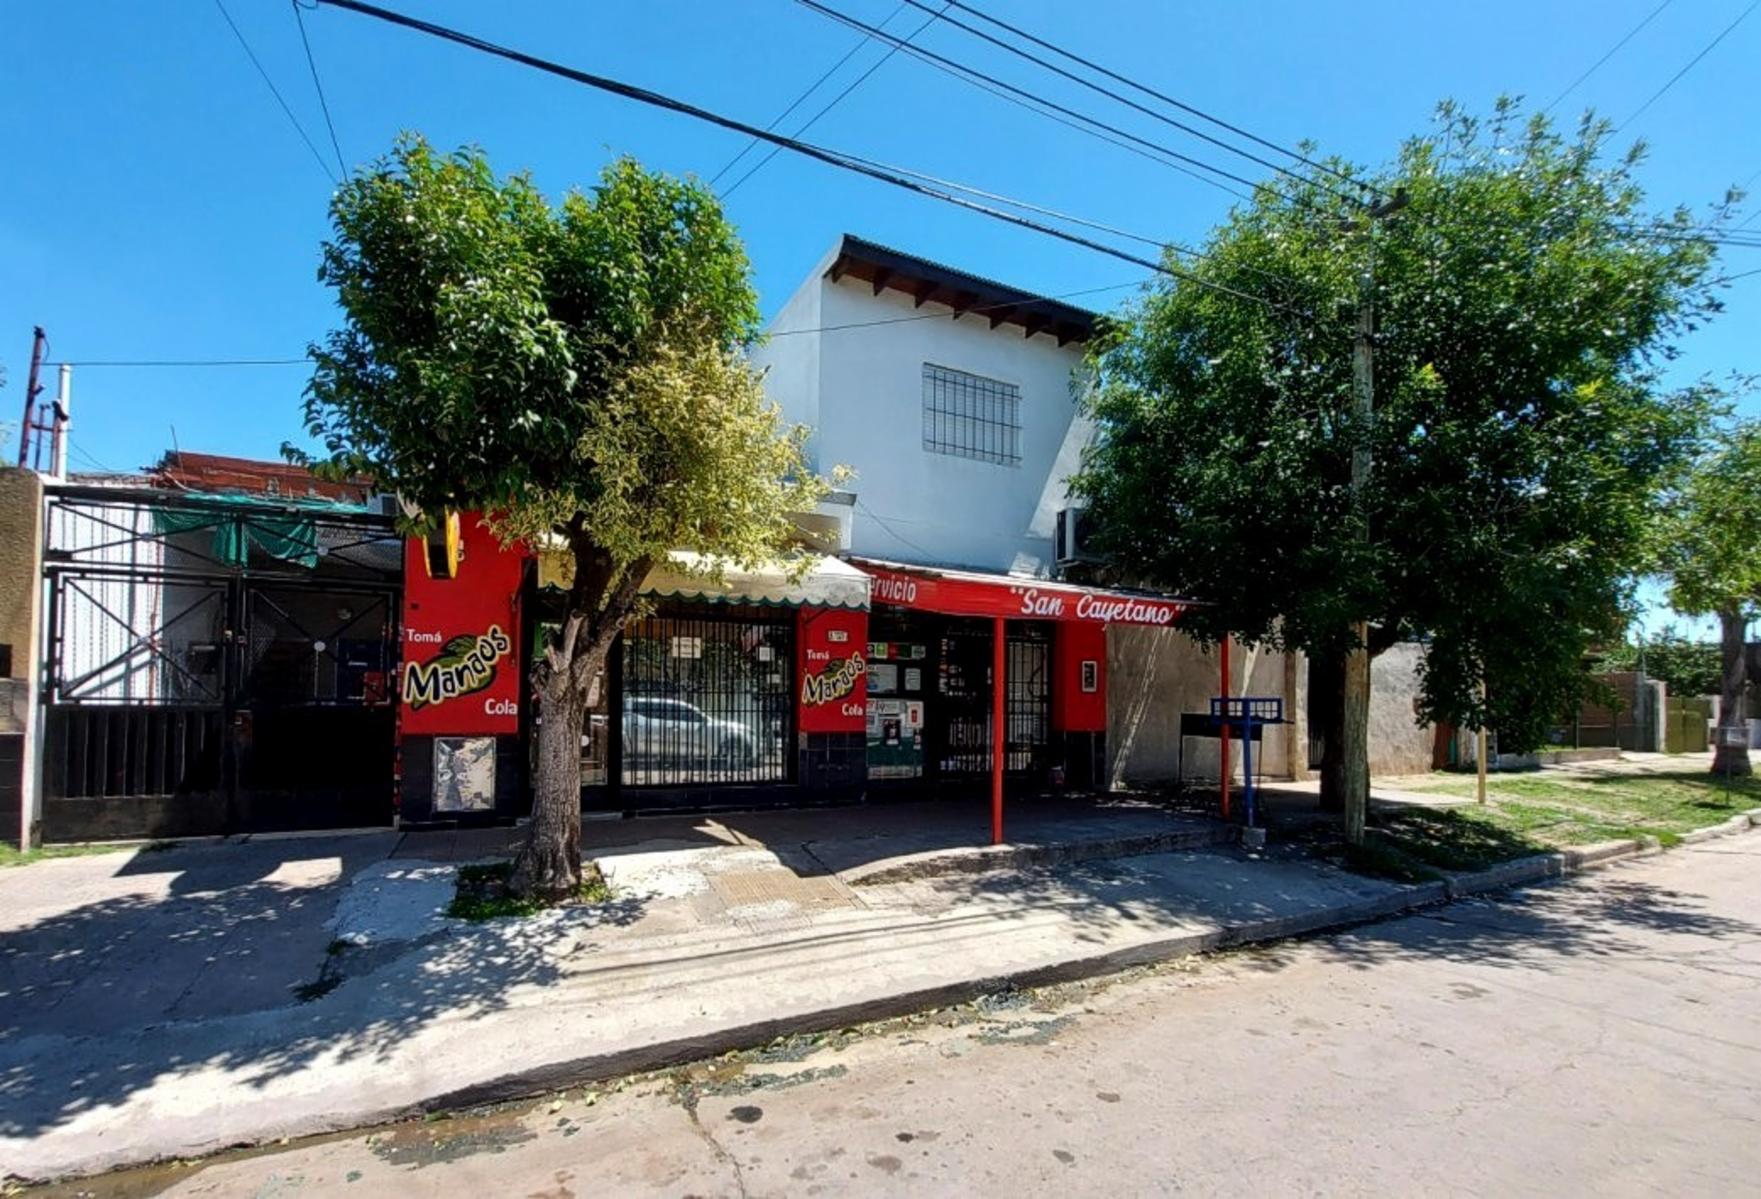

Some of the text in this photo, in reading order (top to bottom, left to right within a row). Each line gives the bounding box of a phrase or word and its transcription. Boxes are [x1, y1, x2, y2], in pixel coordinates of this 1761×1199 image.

[406, 629, 442, 642] Tomá
[403, 625, 510, 704] Manaos
[485, 698, 518, 715] Cola
[841, 702, 864, 716] Cola
